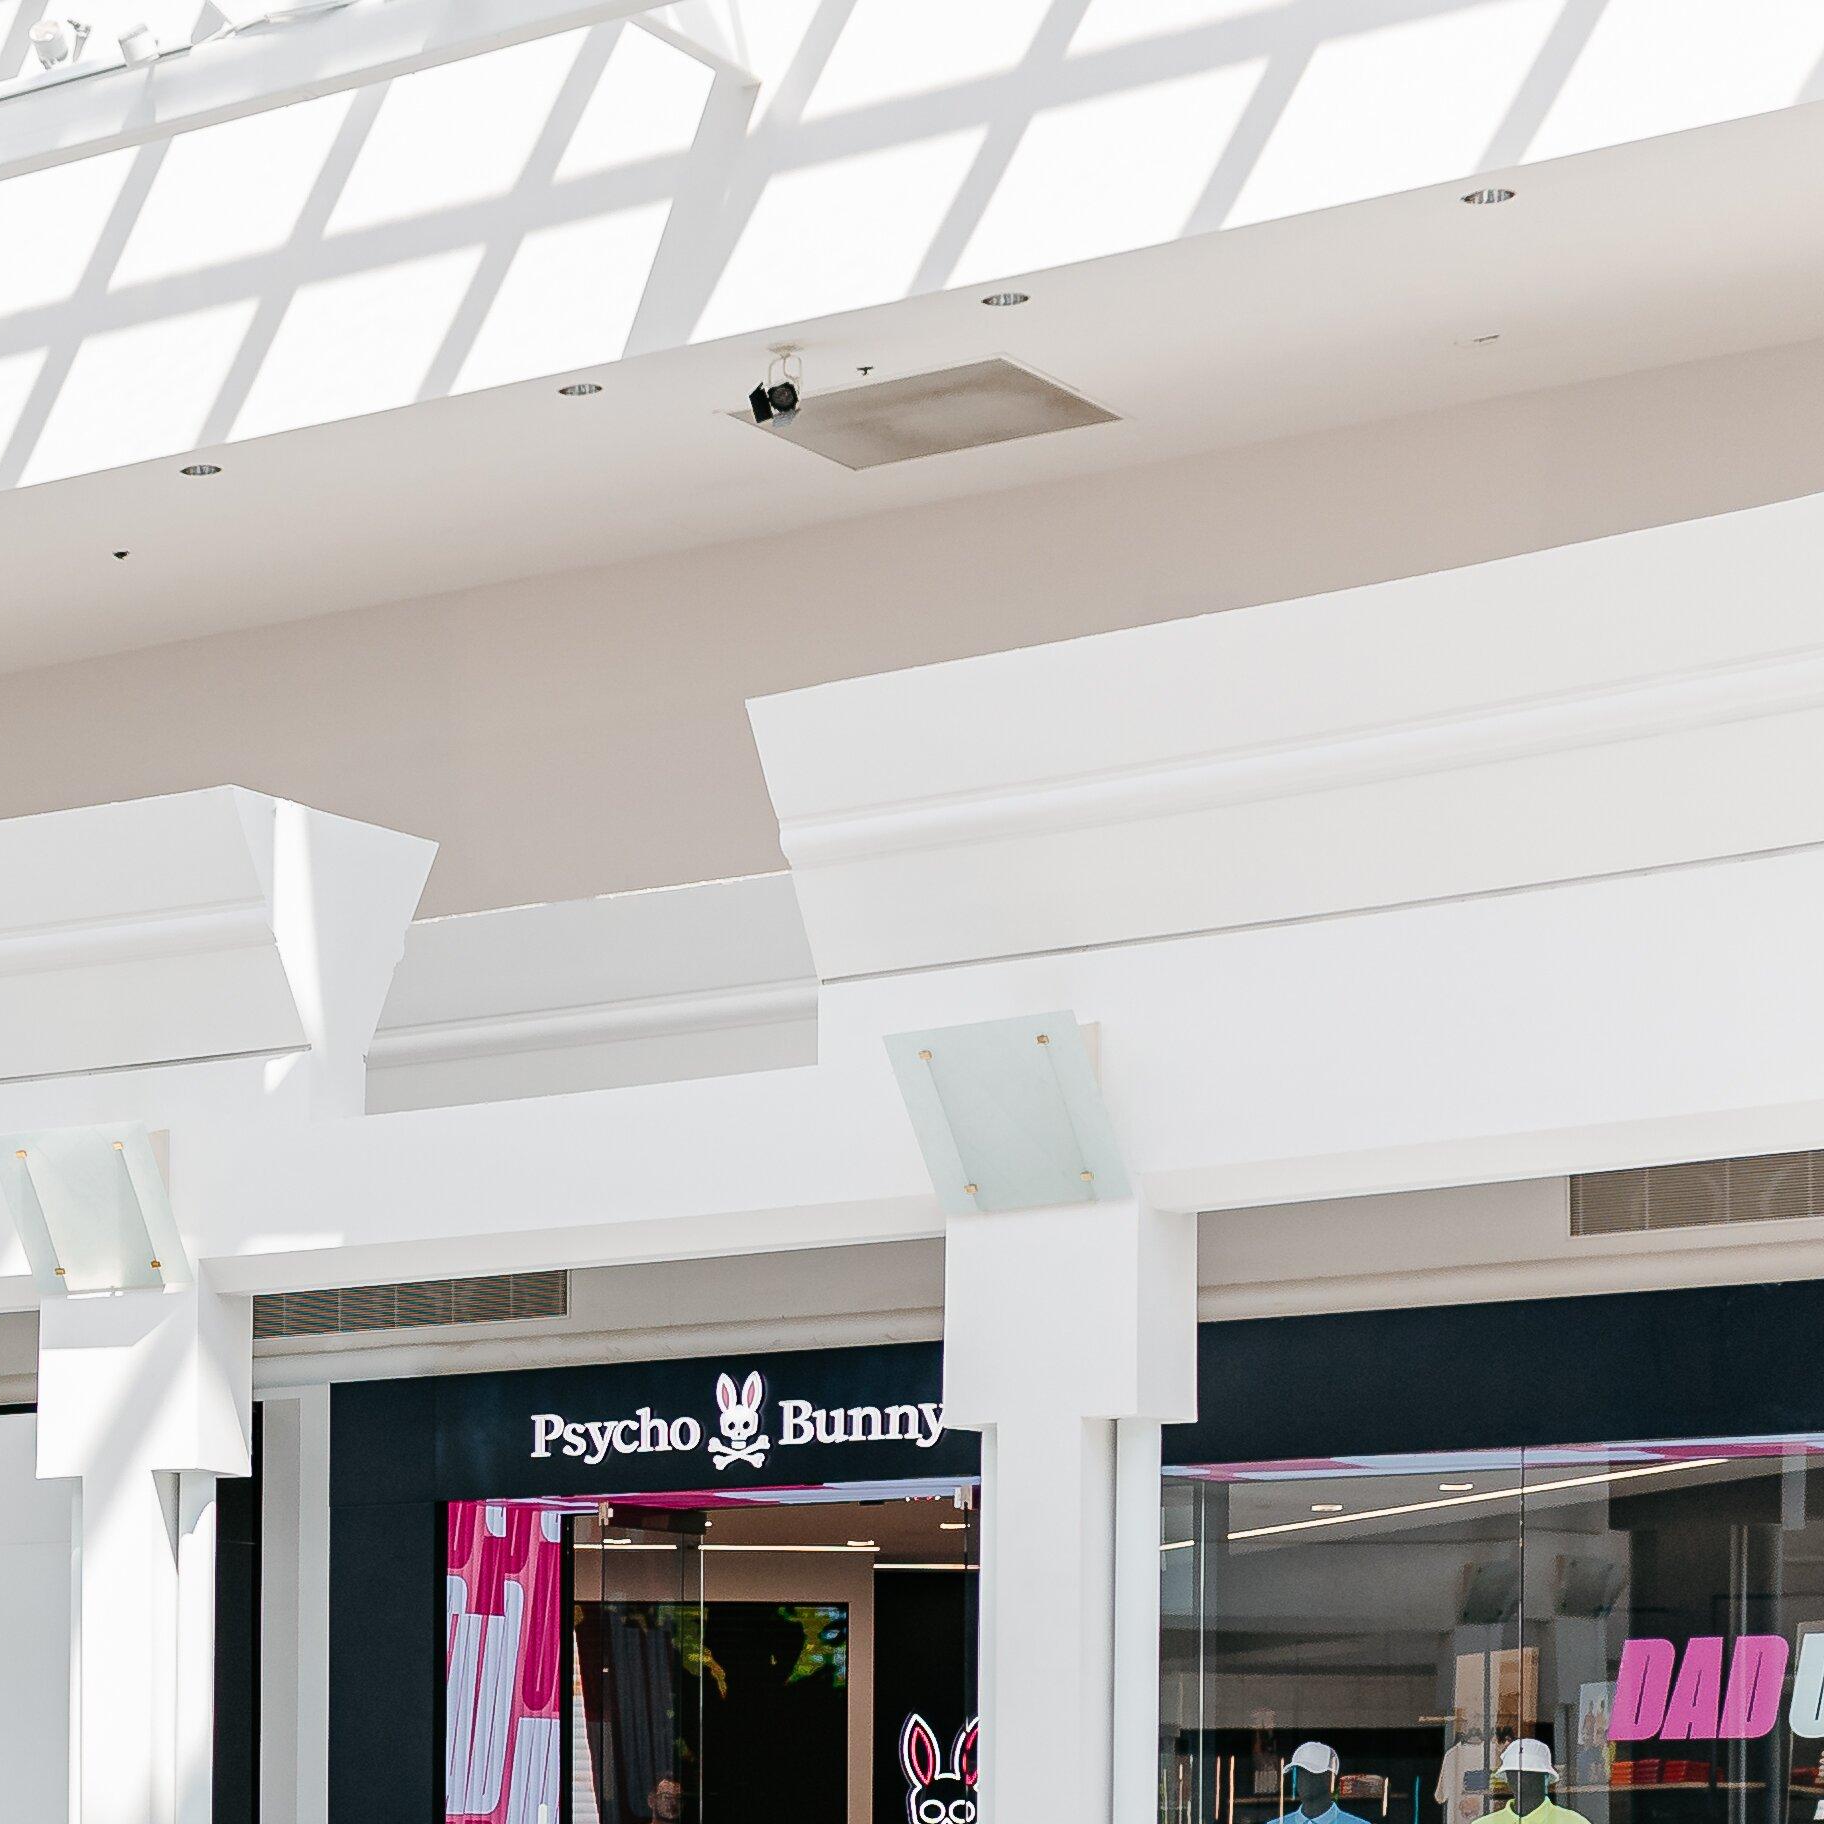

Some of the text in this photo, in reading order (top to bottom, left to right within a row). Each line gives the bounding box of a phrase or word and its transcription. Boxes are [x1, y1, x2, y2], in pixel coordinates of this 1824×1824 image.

[530, 1399, 947, 1465] Psycho Bunny
[1607, 1635, 1789, 1740] DAD
